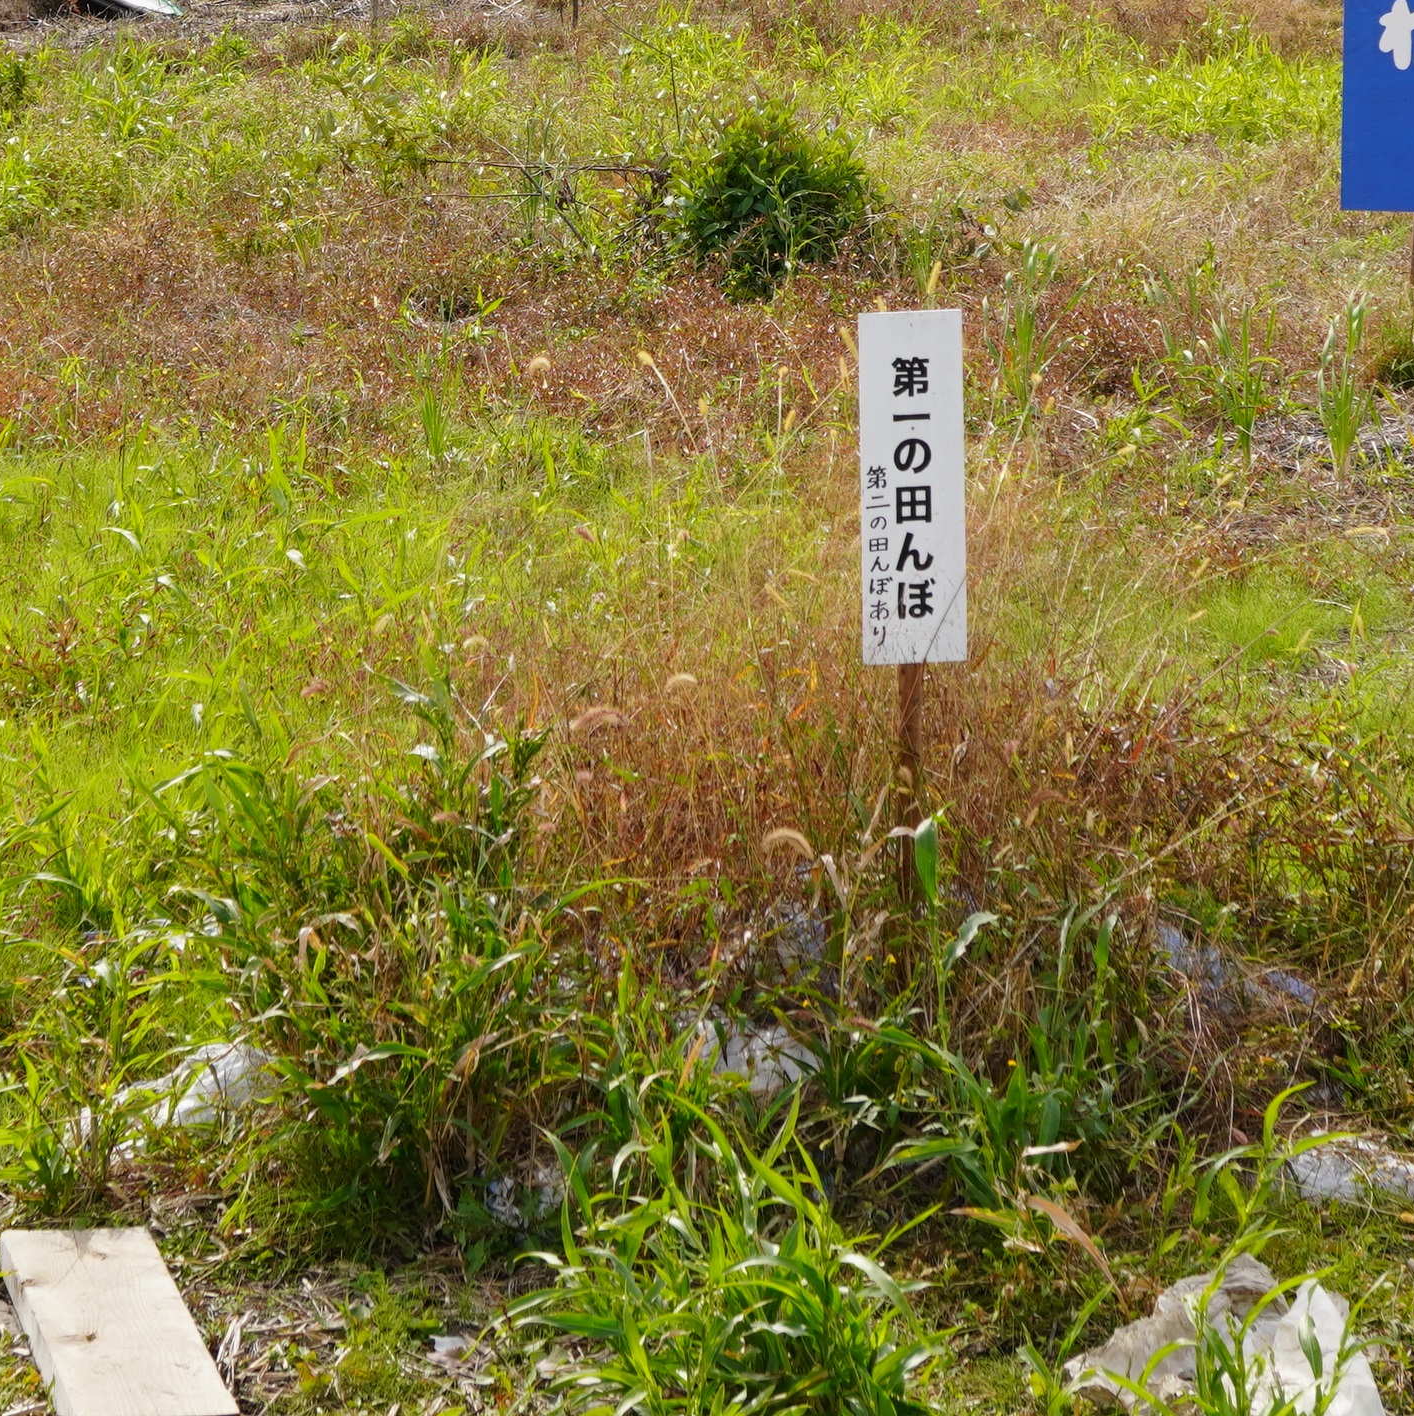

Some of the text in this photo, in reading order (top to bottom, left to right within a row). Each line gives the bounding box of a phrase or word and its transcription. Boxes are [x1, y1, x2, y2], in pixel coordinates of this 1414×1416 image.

[866, 465, 893, 647] 第二の田んぼあり
[891, 357, 934, 620] 第一の田んぼ
